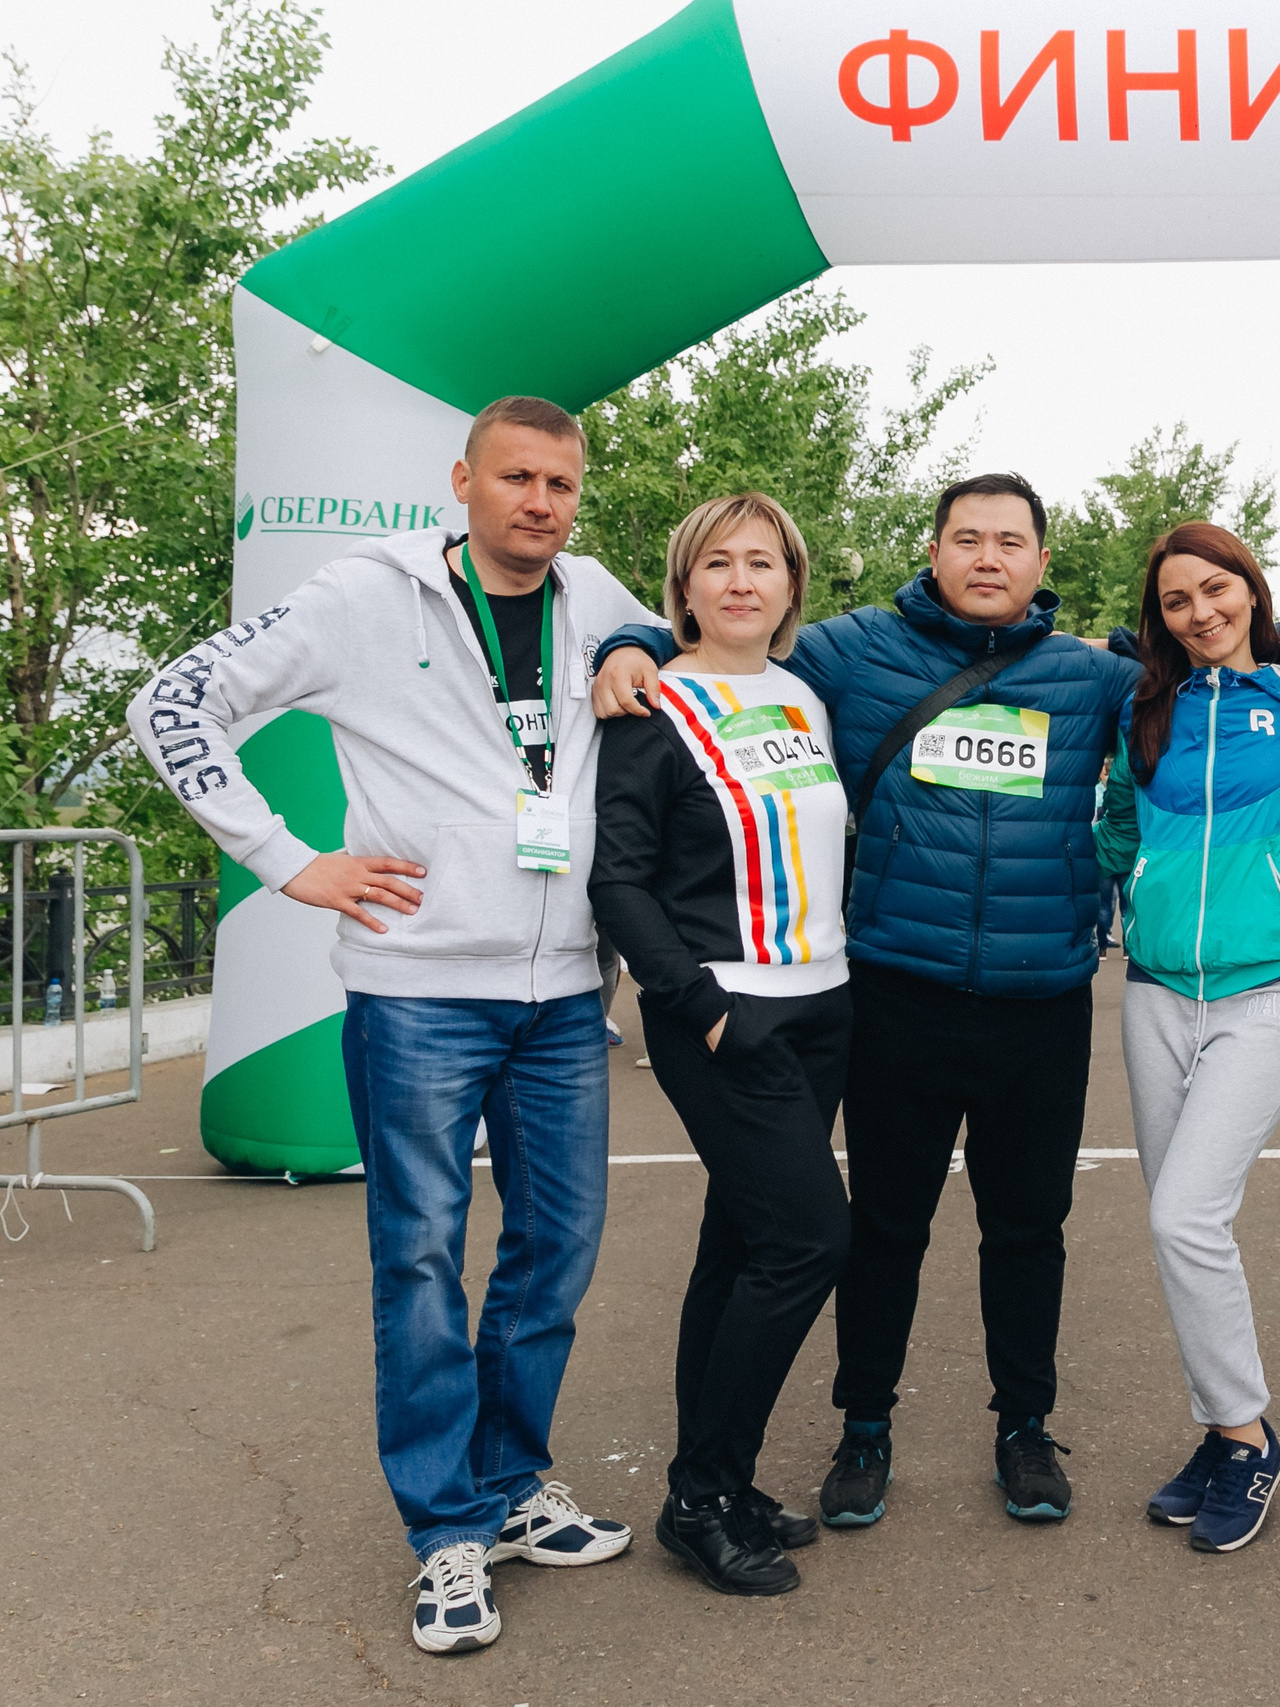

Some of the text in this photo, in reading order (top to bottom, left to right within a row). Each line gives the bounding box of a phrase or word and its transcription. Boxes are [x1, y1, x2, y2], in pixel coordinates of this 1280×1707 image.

[260, 496, 445, 531] СБЕРБАНК
[1249, 708, 1276, 736] R
[762, 734, 826, 765] 0414
[955, 735, 1036, 769] 0666
[958, 769, 998, 784] бежим
[522, 847, 566, 858] ОРГАНИЗАТОР
